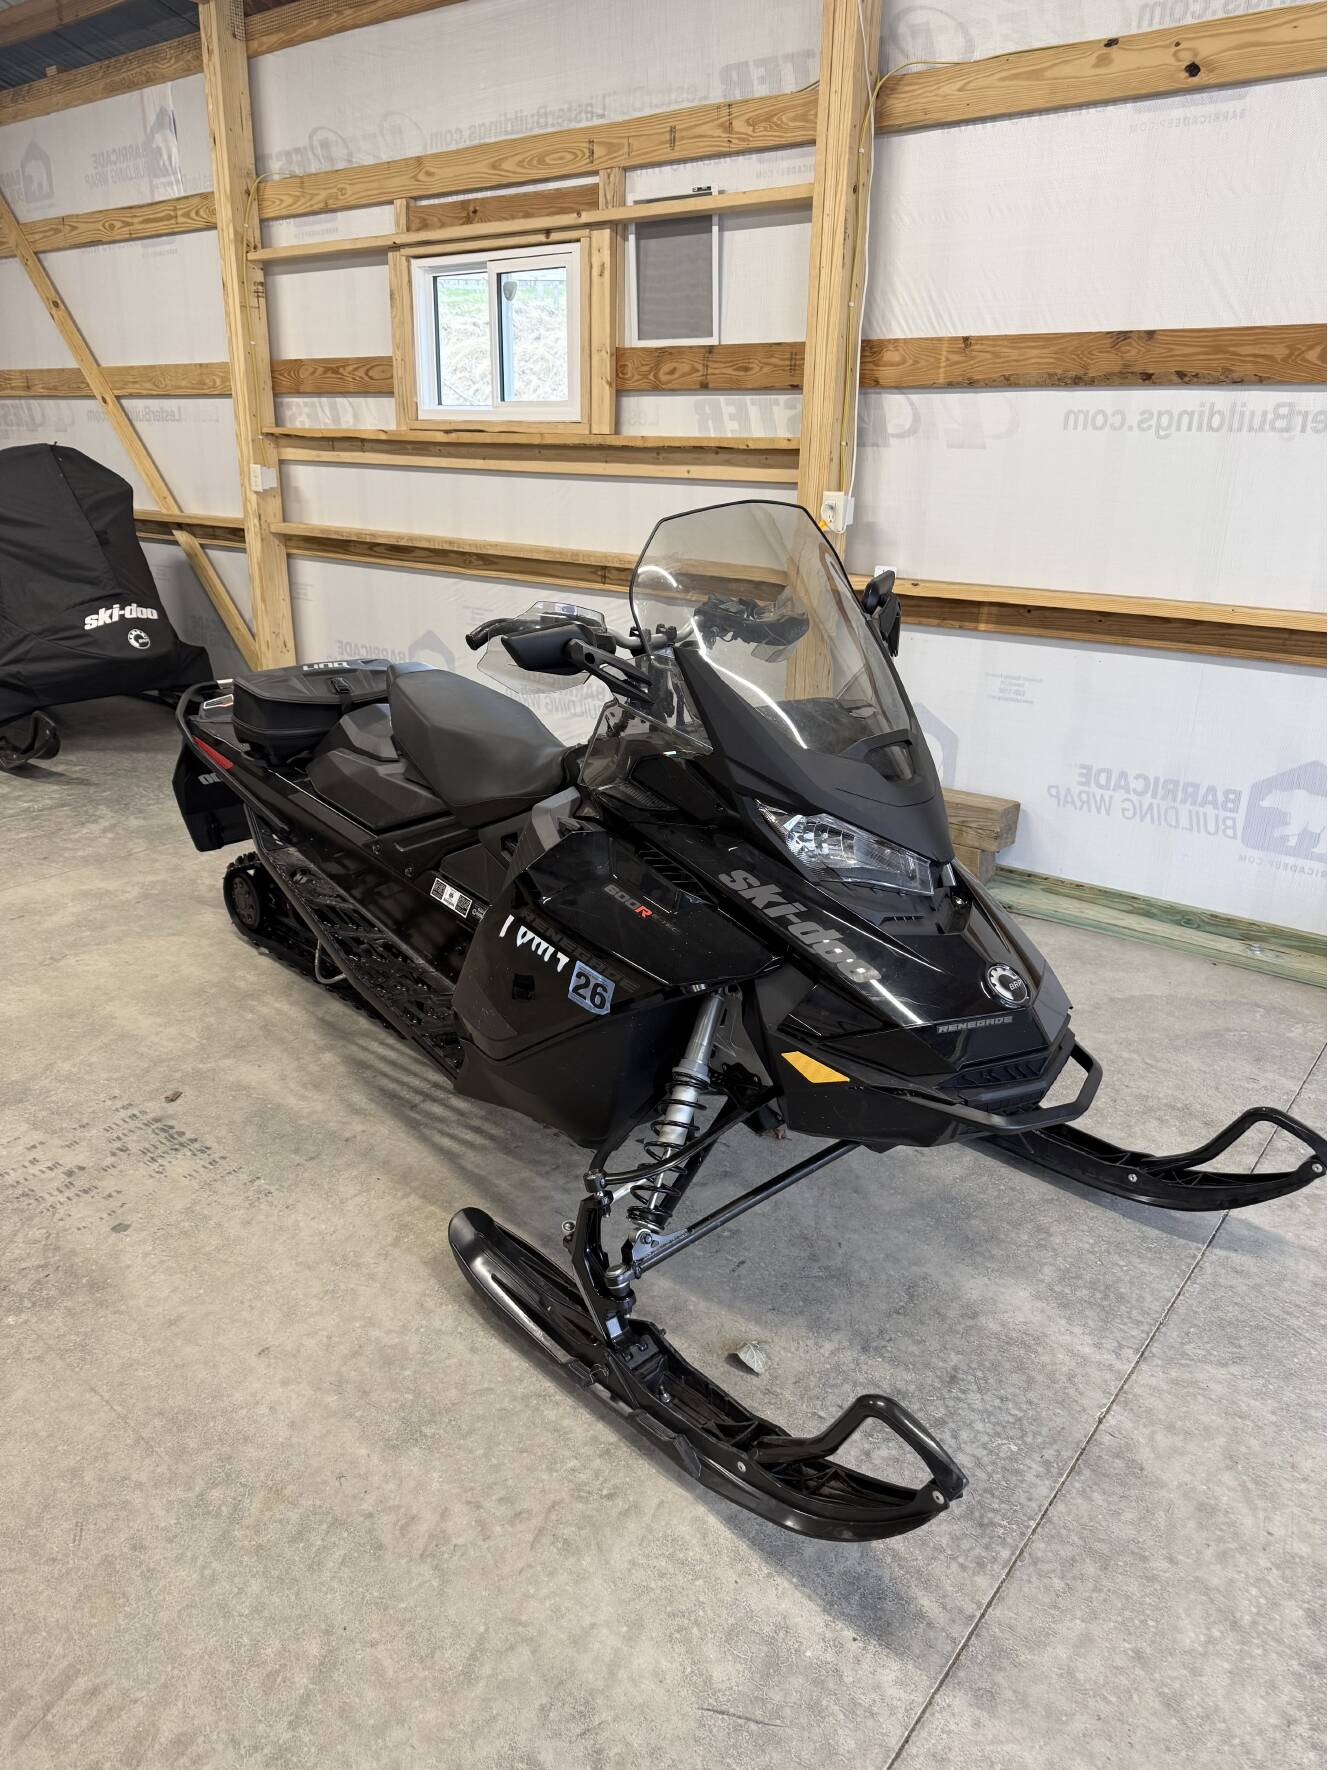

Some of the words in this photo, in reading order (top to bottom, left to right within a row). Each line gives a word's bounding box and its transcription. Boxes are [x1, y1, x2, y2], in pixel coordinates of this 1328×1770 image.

[84, 603, 159, 630] ski-doo
[718, 869, 882, 983] ski-doo
[571, 971, 609, 1010] 26
[937, 1015, 1013, 1034] RENEGADE
